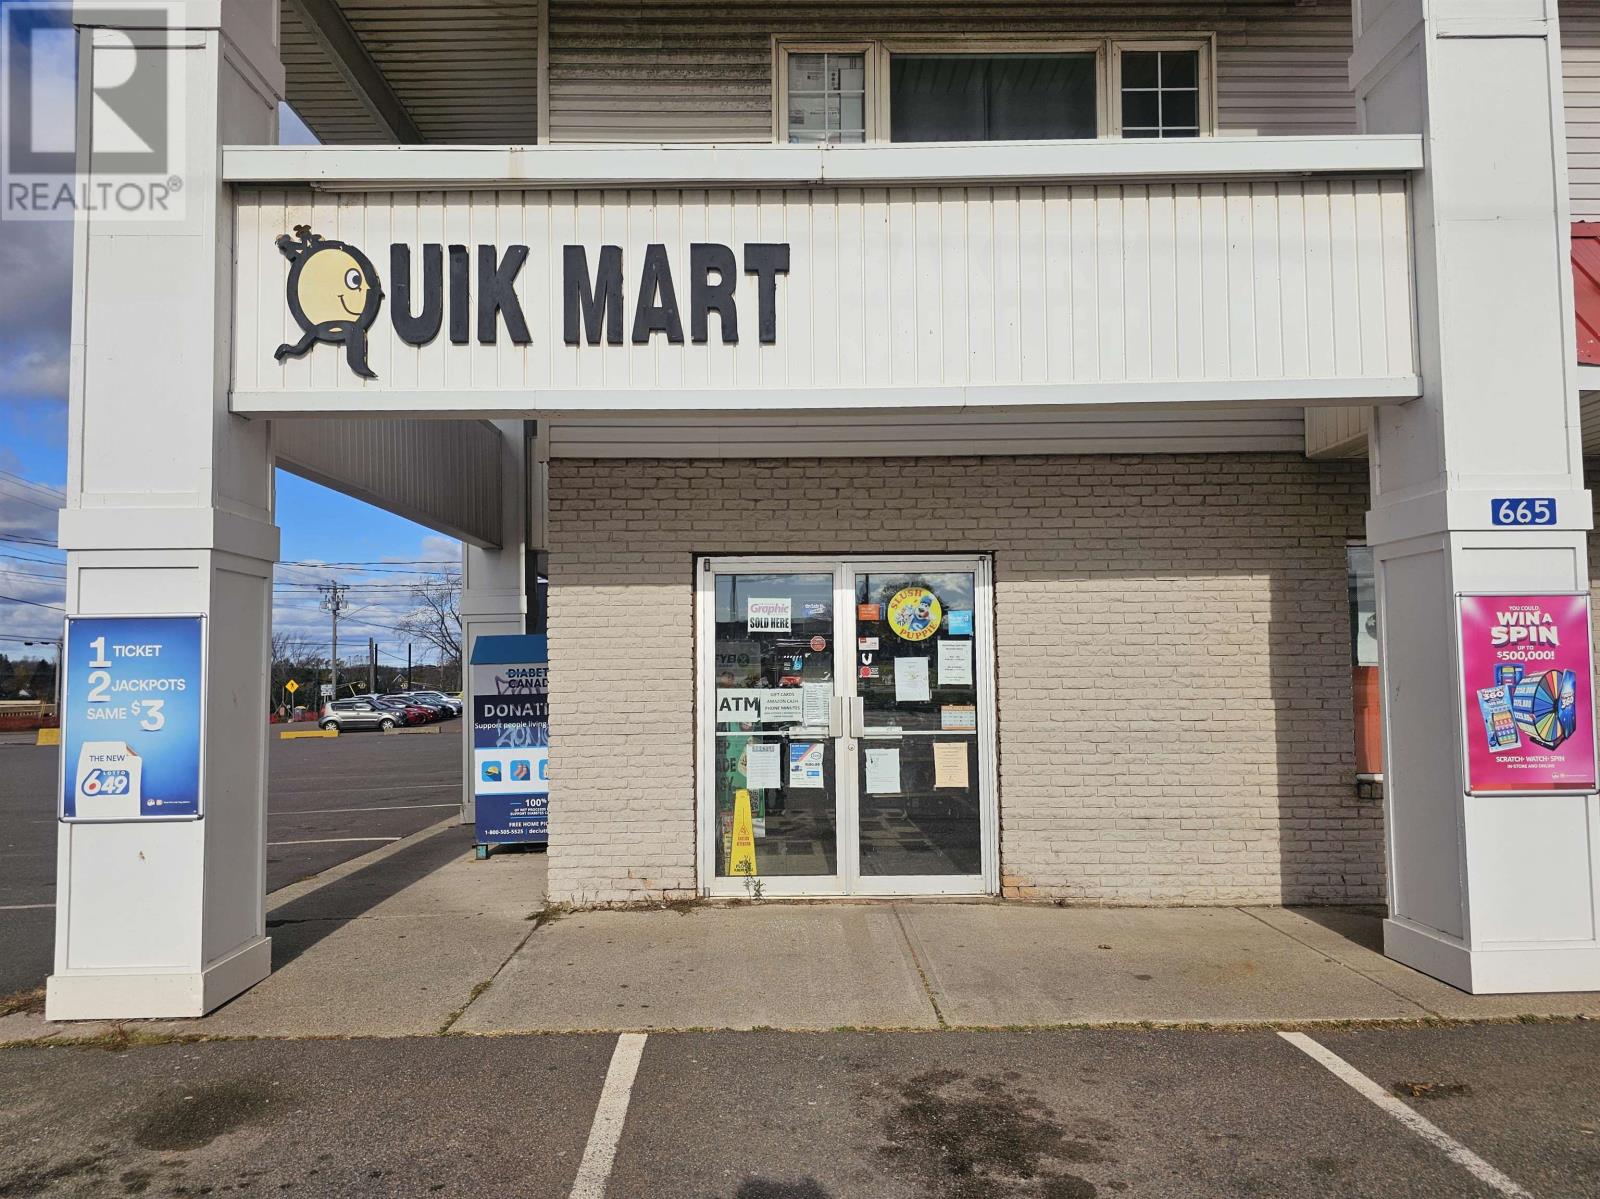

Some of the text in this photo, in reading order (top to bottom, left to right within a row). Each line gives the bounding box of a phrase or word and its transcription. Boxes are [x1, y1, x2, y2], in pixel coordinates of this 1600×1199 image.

[563, 243, 790, 345] MART
[1499, 500, 1550, 524] 665
[891, 589, 922, 609] SLUSH
[751, 603, 789, 615] Graphic
[750, 617, 790, 629] SOLD HERE
[1496, 611, 1552, 626] WIN A
[900, 623, 938, 640] PUPPIE
[1491, 626, 1560, 647] SPIN
[89, 637, 162, 668] 1 TICKET
[1497, 651, 1555, 662] $500,000!
[88, 671, 186, 702] 2 JACKPOTS
[719, 697, 758, 712] ATM
[86, 700, 166, 732] SAME $3
[474, 722, 502, 731] Support
[504, 721, 527, 730] people
[525, 799, 547, 807] 100%
